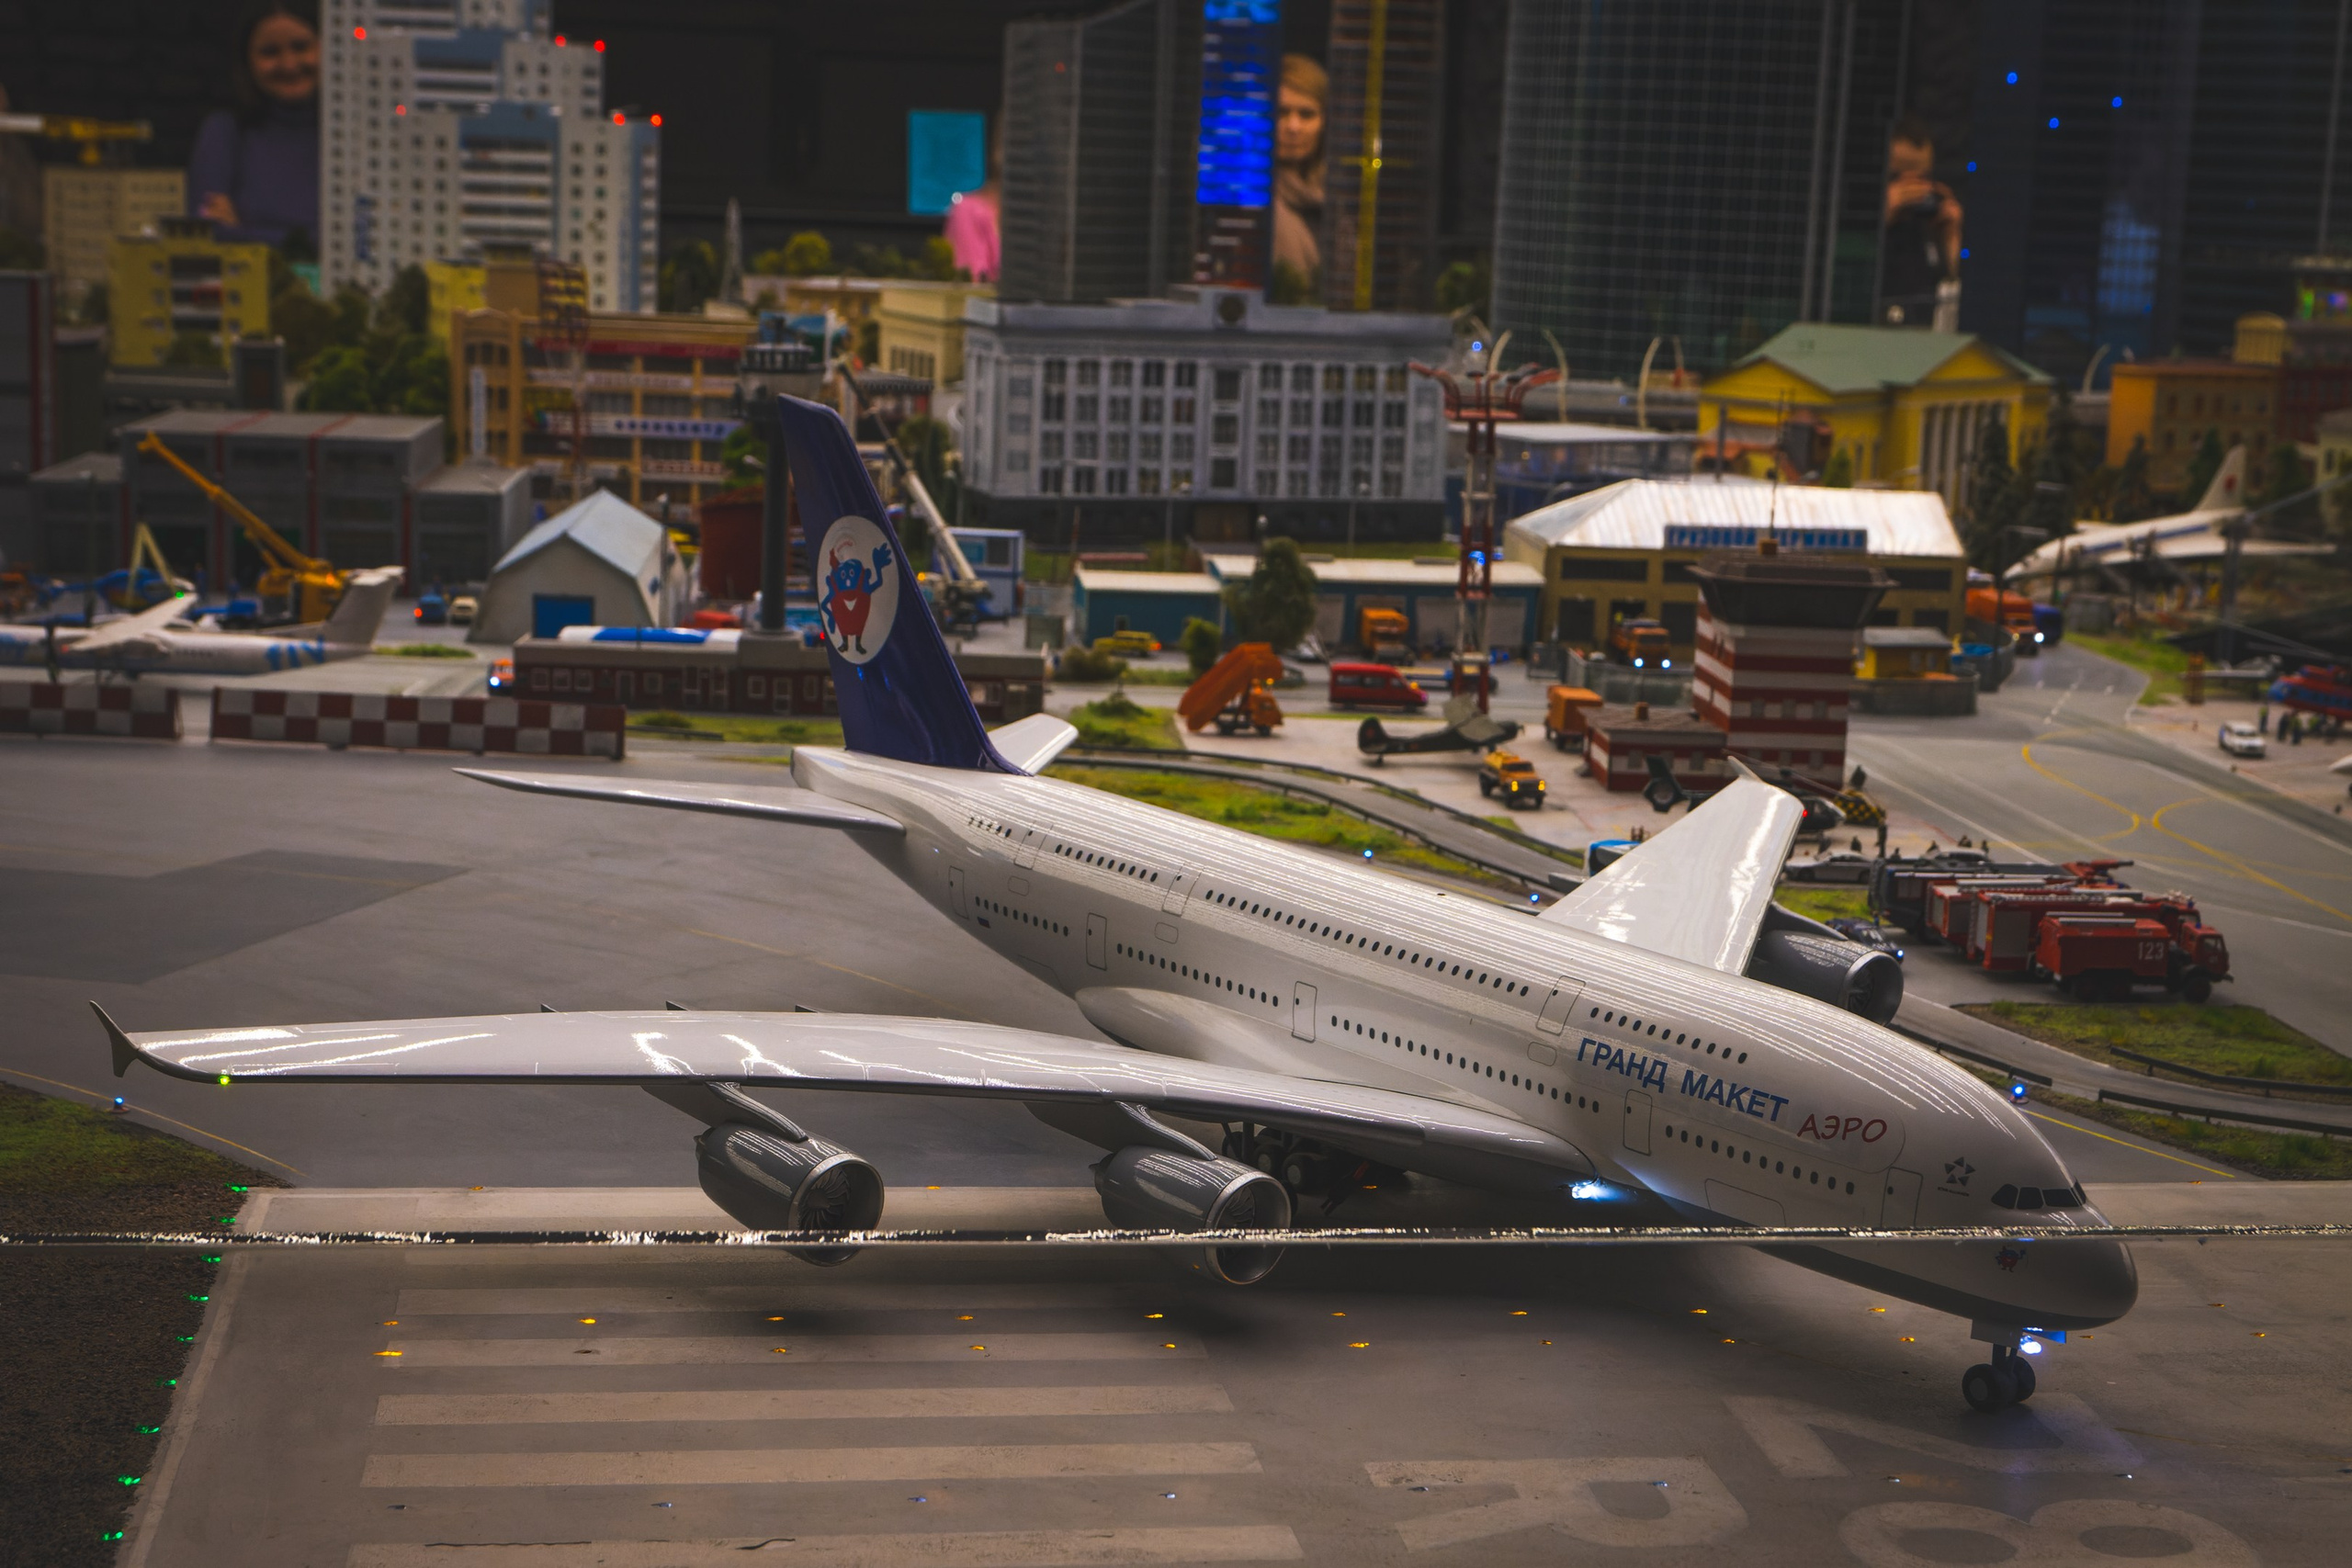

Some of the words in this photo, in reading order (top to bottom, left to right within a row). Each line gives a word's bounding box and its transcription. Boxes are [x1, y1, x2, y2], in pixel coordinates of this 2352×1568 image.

[2137, 941, 2165, 961] 123
[1577, 1037, 1668, 1094] ГРАНД
[1679, 1069, 1790, 1122] МАКЕТ
[1795, 1112, 1888, 1144] АЭРО
[1363, 1456, 1749, 1554] R
